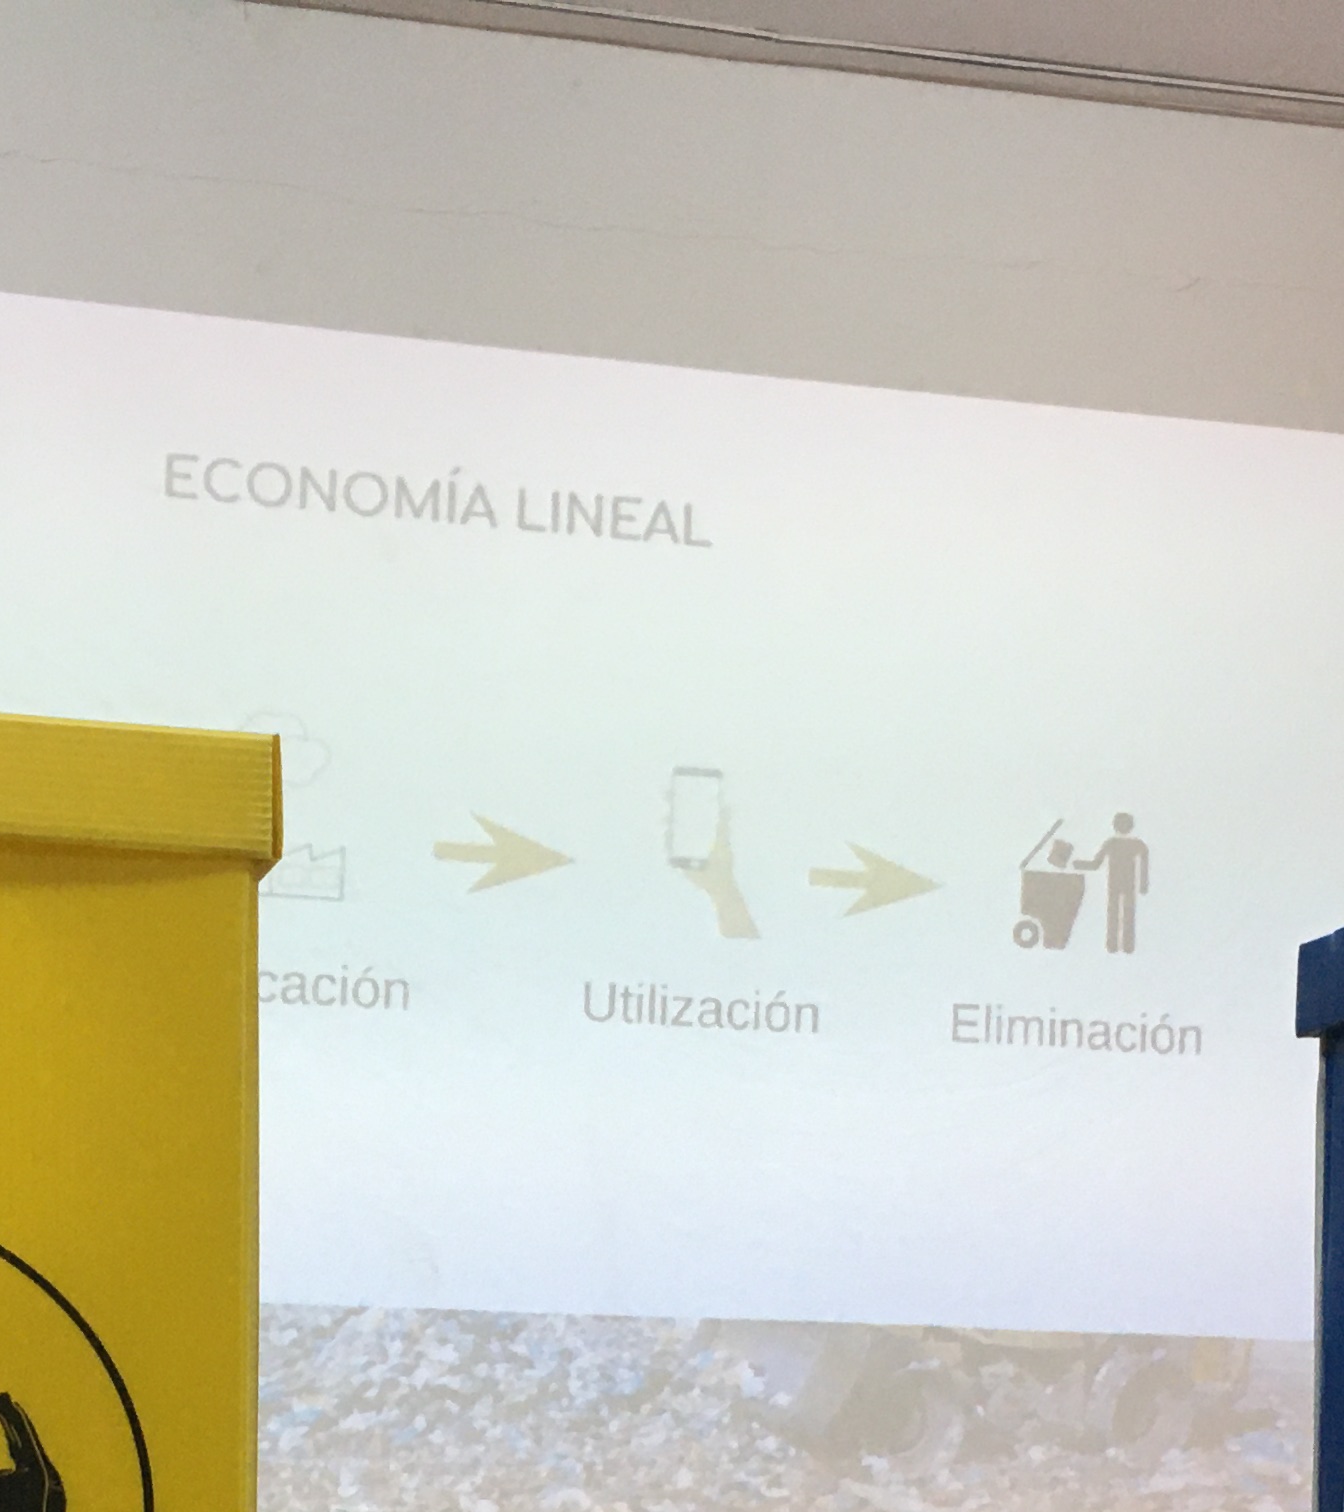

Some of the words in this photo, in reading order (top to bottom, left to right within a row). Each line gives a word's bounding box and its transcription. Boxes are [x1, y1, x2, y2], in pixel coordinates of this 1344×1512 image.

[164, 452, 497, 528] ECONOMÍA
[516, 488, 712, 547] LINEAL
[582, 980, 821, 1036] Utilización
[950, 1000, 1204, 1058] Eliminación
